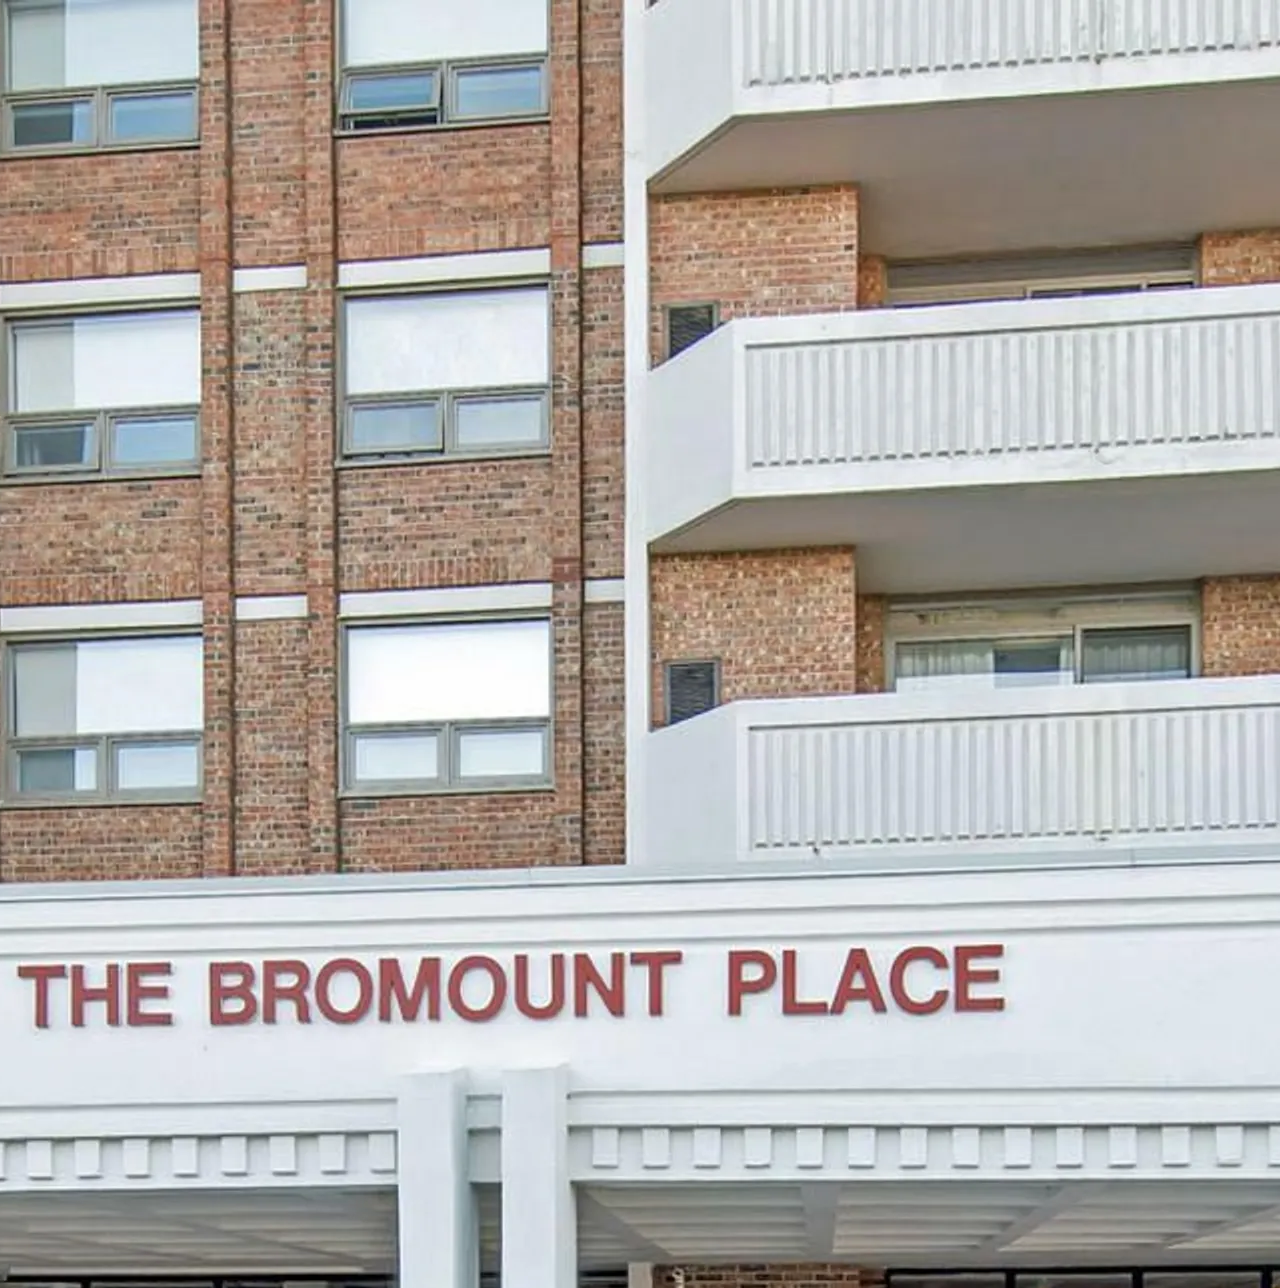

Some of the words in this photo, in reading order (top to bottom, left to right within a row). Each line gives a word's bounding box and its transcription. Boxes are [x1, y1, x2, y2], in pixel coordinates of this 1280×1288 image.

[18, 961, 173, 1027] THE
[208, 951, 682, 1026] BROMOUNT
[726, 943, 1005, 1016] PLACE
